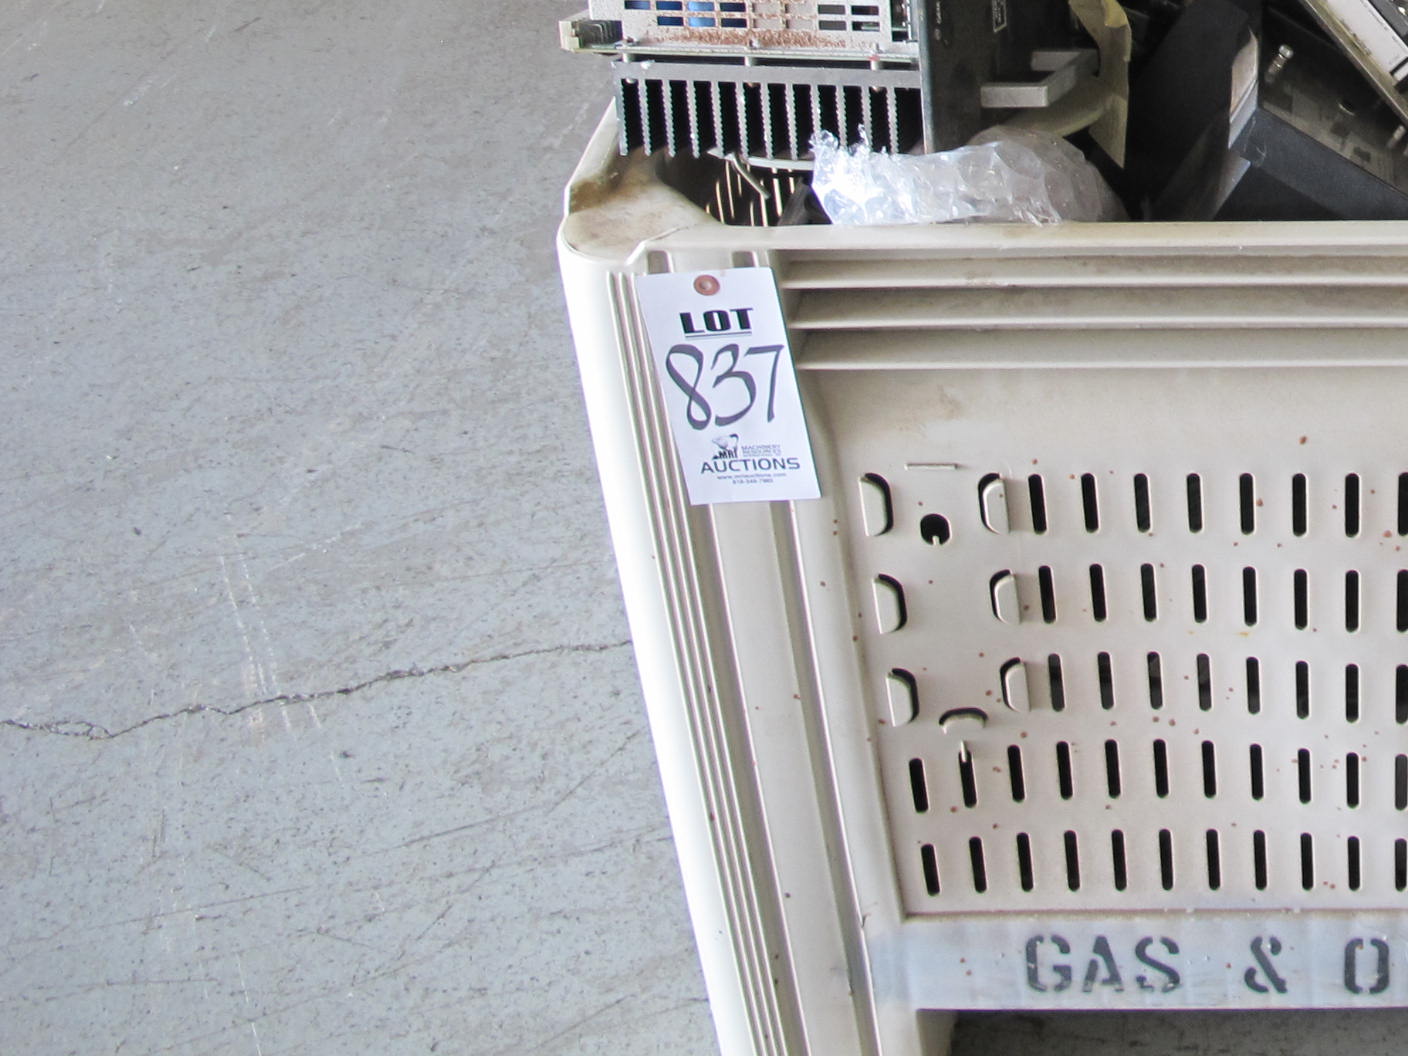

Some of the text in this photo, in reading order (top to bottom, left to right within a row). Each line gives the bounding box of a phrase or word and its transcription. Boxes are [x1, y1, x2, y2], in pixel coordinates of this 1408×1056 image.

[679, 307, 754, 334] LOT
[665, 343, 785, 431] 837
[700, 457, 801, 474] AUCTIONS
[1025, 934, 1182, 993] GAS
[1243, 935, 1289, 994] &
